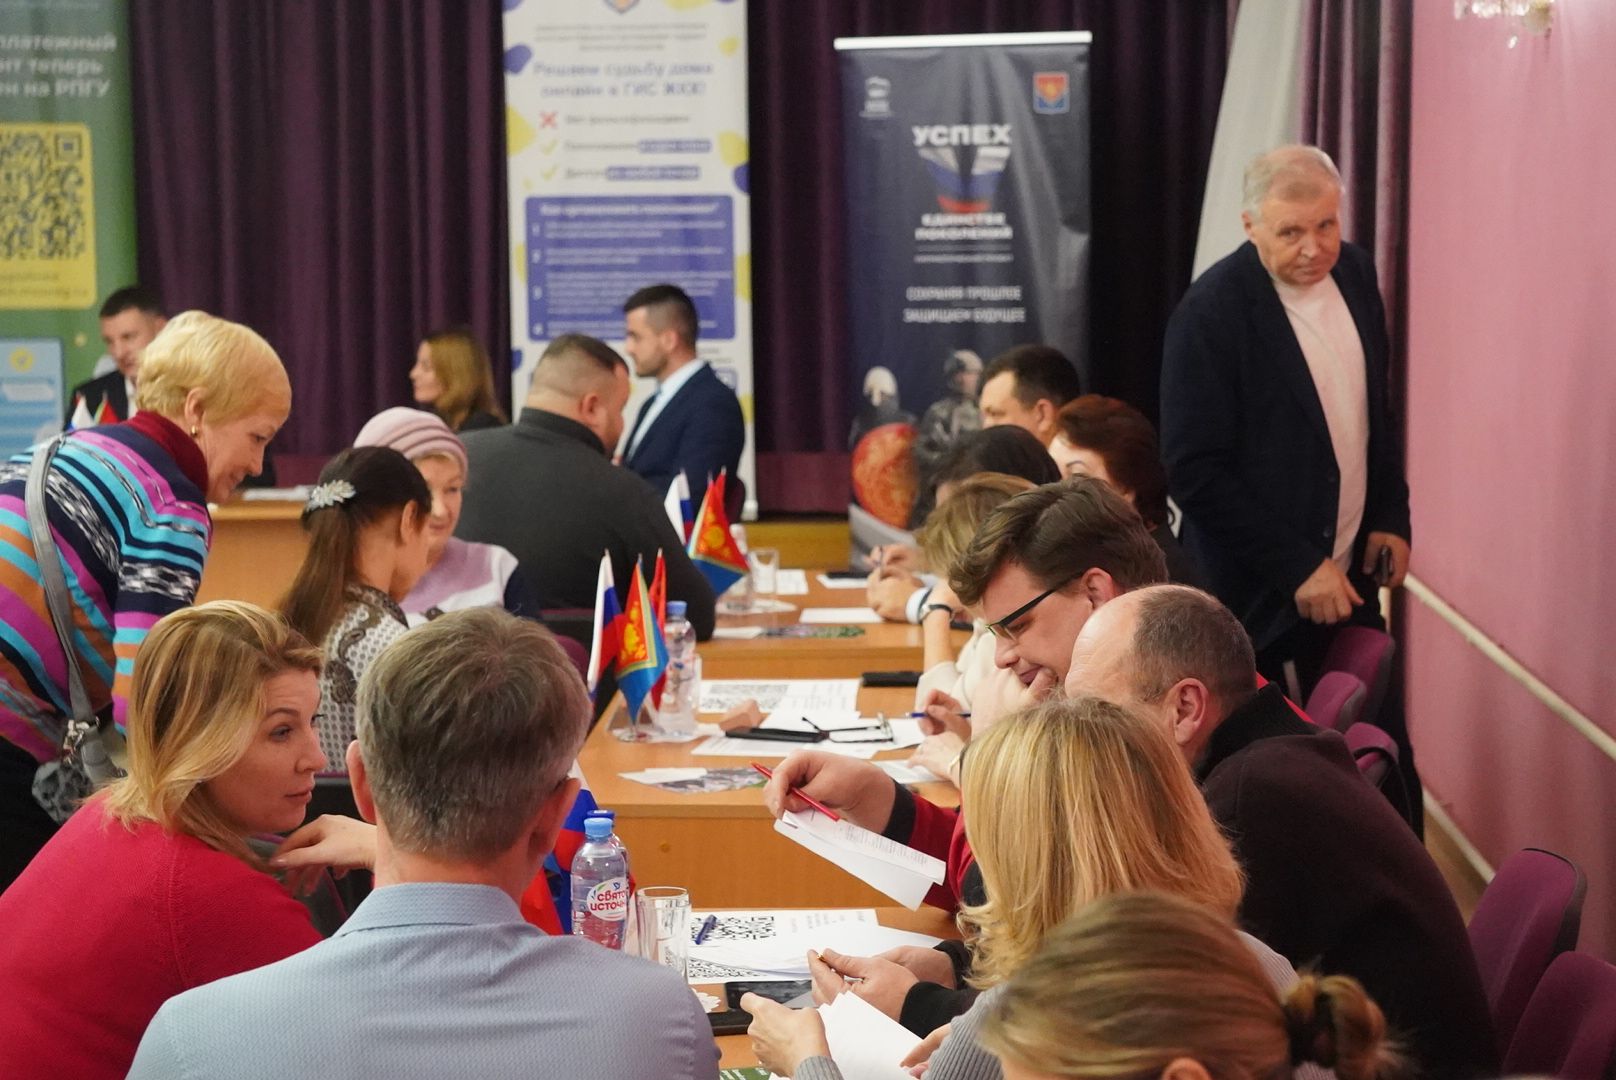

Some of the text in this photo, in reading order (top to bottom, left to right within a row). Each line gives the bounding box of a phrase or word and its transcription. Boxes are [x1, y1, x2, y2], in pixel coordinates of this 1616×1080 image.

[31, 59, 103, 77] теперь
[55, 79, 110, 97] РПГУ
[623, 83, 657, 96] ГИС
[912, 124, 1012, 146] УСПЕХ
